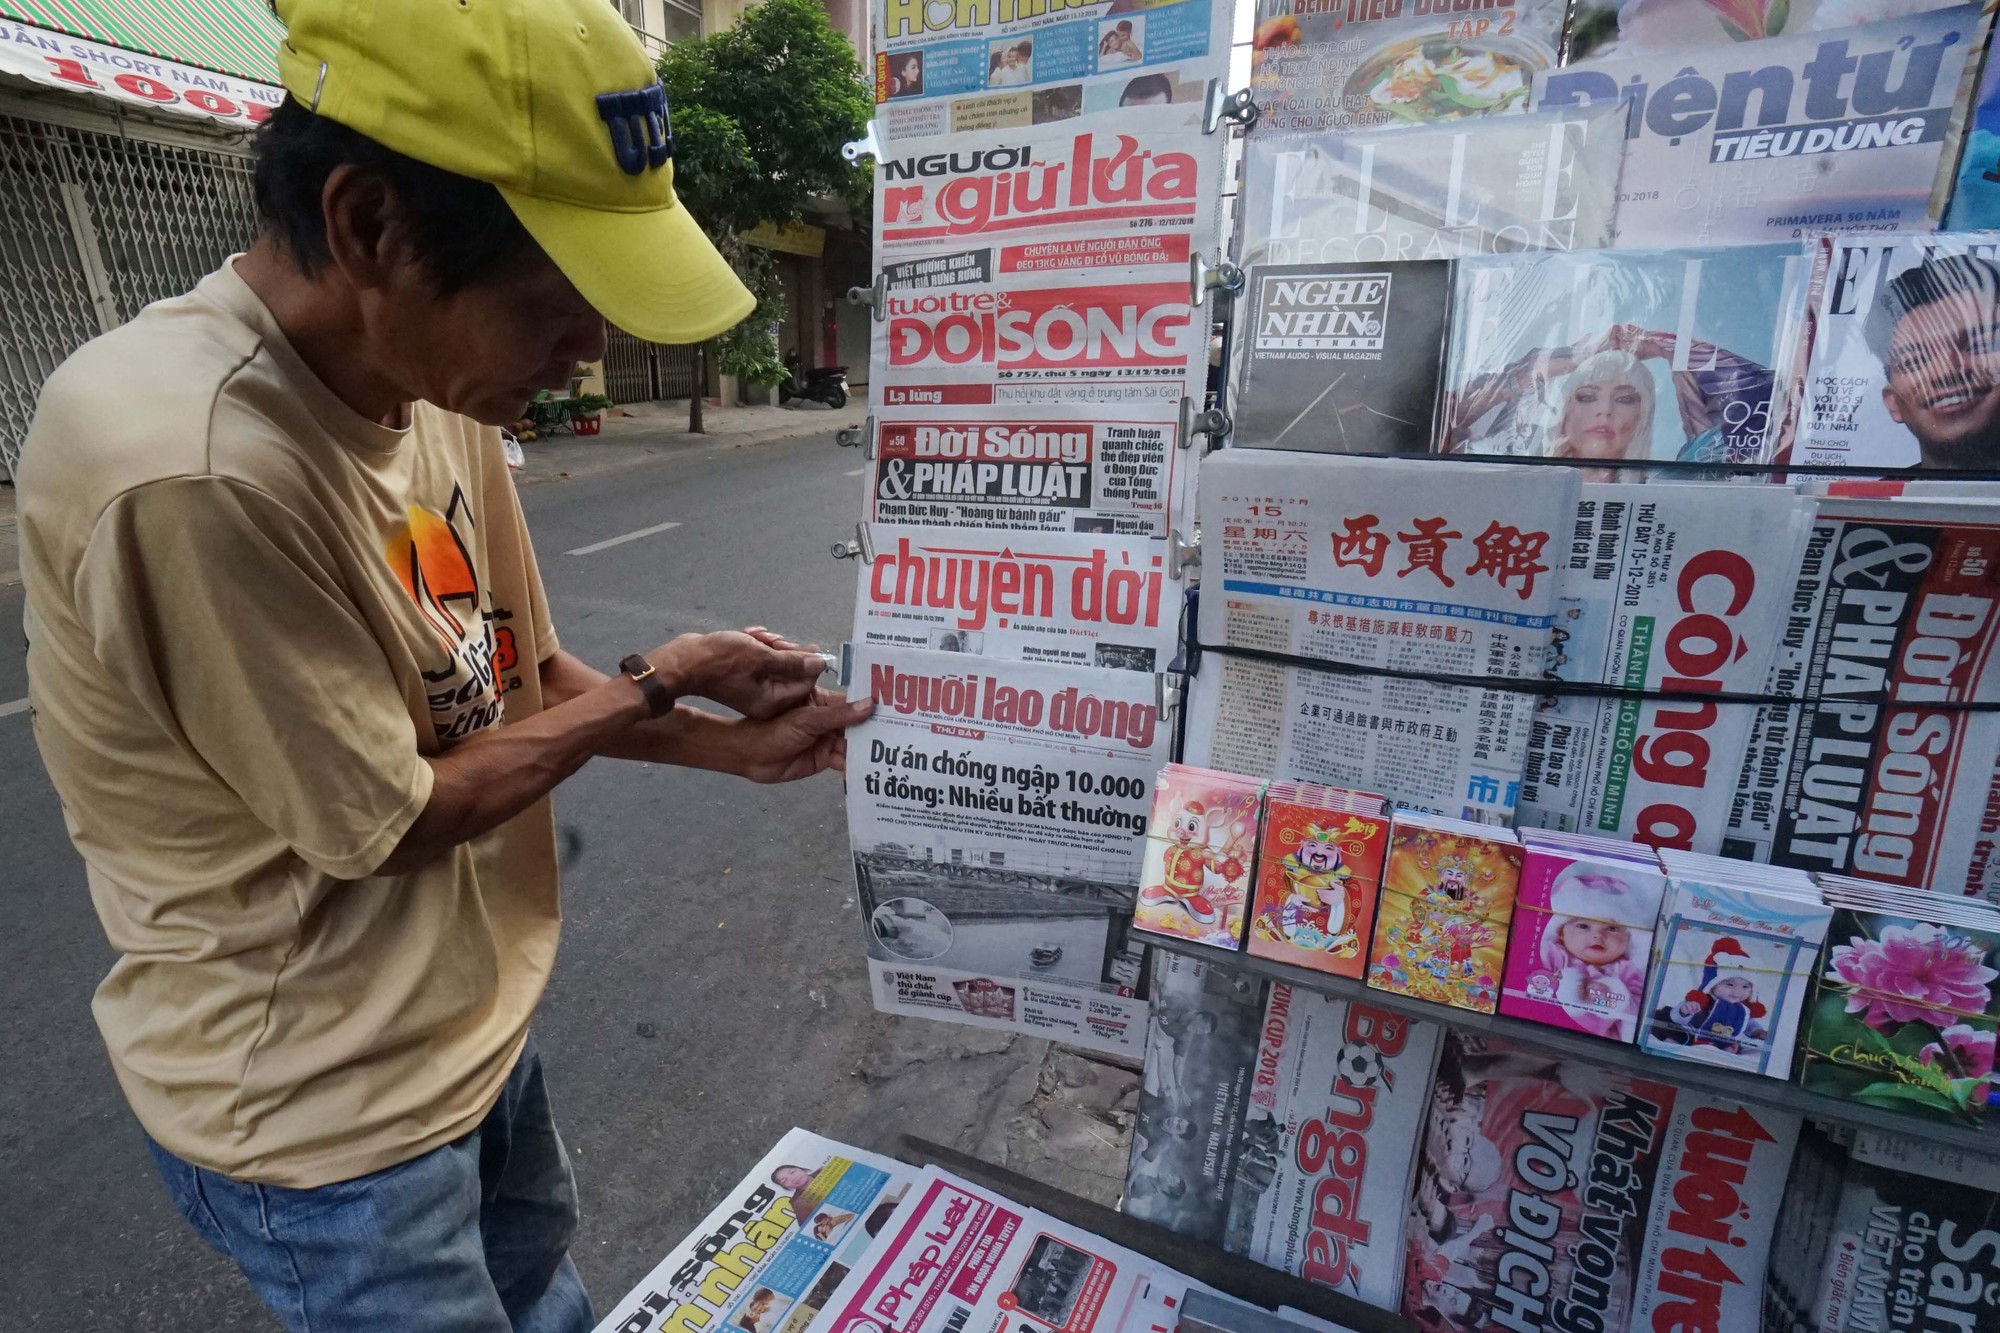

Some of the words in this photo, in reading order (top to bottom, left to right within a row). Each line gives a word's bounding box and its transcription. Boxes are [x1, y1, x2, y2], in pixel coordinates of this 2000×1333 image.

[1447, 14, 1490, 44] TẬP
[1498, 10, 1517, 36] 2
[70, 44, 161, 77] SHORT
[172, 69, 229, 93] NAM
[1290, 114, 1313, 127] CHO
[1713, 129, 1801, 162] TIÊU
[1802, 117, 1925, 155] DÙNG
[885, 145, 1031, 181] NGƯỜI
[935, 160, 1066, 236] giữ
[1633, 190, 1660, 202] 2018
[1139, 218, 1153, 228] 276
[1766, 213, 1843, 227] PRIMAVERA
[1847, 211, 1863, 223] 50
[1865, 207, 1900, 222] NĂM
[1024, 245, 1058, 257] CHUYỆN
[1087, 239, 1116, 252] NGƯỜI
[1117, 238, 1139, 250] ĐÀN
[1140, 237, 1161, 248] ÔNG
[1034, 259, 1056, 268] 13KG
[1056, 255, 1083, 267] VÀNG
[1084, 256, 1094, 266] ĐI
[1124, 251, 1150, 263] BÓNG
[896, 265, 914, 279] VIỆT
[916, 258, 947, 273] HƯƠNG
[931, 270, 956, 285] RƯNG
[958, 266, 982, 281] RƯNG
[1269, 280, 1386, 306] NGHE
[998, 302, 1191, 362] SỐNG
[1261, 305, 1374, 336] NHÌN
[1262, 339, 1376, 347] VIETNAM
[1287, 352, 1310, 360] AUDIO
[1316, 352, 1341, 360] VISUAL
[1343, 352, 1383, 361] MAGAZINE
[1117, 367, 1186, 377] 13/12/2018
[889, 389, 906, 405] Lạ
[998, 388, 1013, 399] Thu
[1030, 387, 1045, 397] khu
[1048, 384, 1061, 397] đất
[1065, 387, 1086, 400] vàng
[1097, 388, 1121, 400] trung
[1124, 387, 1141, 397] tâm
[1144, 386, 1157, 397] Sài
[1160, 386, 1180, 397] Gòn
[1723, 400, 1772, 433] 95
[1814, 404, 1860, 413] MUAY
[914, 426, 980, 457] Đời
[983, 425, 1088, 463] Sống
[1102, 439, 1133, 450] quanh
[1135, 439, 1164, 451] chiếc
[1107, 427, 1136, 438] Tranh
[1138, 428, 1160, 440] luận
[1101, 451, 1116, 462] thẻ
[1118, 450, 1140, 464] điệp
[1142, 451, 1164, 463] viên
[1112, 463, 1137, 475] Đông
[1139, 464, 1158, 475] Đức
[913, 460, 999, 495] PHÁP
[1002, 461, 1088, 502] LUẬT
[1103, 487, 1130, 500] thống
[1132, 488, 1157, 500] Putin
[1109, 475, 1126, 486] của
[1128, 475, 1152, 488] Tổng
[879, 502, 906, 517] Phạm
[908, 503, 927, 516] Đức
[929, 505, 949, 519] Huy
[956, 506, 994, 521] "Hoàng
[1009, 508, 1036, 521] bánh
[1131, 502, 1152, 510] Trang
[1247, 505, 1282, 516] 15
[1223, 525, 1308, 542] 星期六
[1802, 526, 1835, 576] Phạm
[1624, 548, 1647, 607] 15-12-2018
[1959, 557, 1988, 577] 50
[870, 538, 1053, 630] chuyện
[1071, 549, 1163, 628] đời
[1792, 578, 1818, 613] Đức
[1782, 616, 1812, 649] Huy
[1895, 593, 1994, 702] Đời
[1628, 623, 1650, 685] THÀNH
[1818, 588, 1908, 734] PHÁP
[871, 663, 978, 720] Người
[982, 676, 1044, 727] lao
[1050, 686, 1157, 749] động
[936, 725, 955, 734] THỨ
[957, 727, 980, 738] BẢY
[871, 739, 900, 772] Dự
[902, 743, 928, 771] án
[932, 749, 997, 787] chống
[1002, 758, 1060, 794] ngập
[1065, 770, 1145, 799] 10.000
[1611, 753, 1626, 782] CHÍ
[865, 769, 880, 796] tỉ
[884, 775, 945, 809] đồng:
[949, 785, 1014, 815] Nhiều
[1018, 794, 1056, 821] bất
[1061, 801, 1147, 836] thường
[1602, 784, 1620, 825] MINH
[1789, 737, 1872, 870] LUẬT
[1853, 712, 1951, 878] Sống
[896, 971, 914, 982] Việt
[915, 973, 936, 983] Nam
[1122, 987, 1130, 997] 4
[911, 989, 936, 1000] giành
[937, 992, 952, 1002] cúp
[1264, 1020, 1286, 1048] CUP
[1258, 1049, 1280, 1087] 2018
[1211, 1105, 1224, 1127] NAM
[1202, 1131, 1221, 1177] MALAYSIA
[1583, 1088, 1660, 1218] Khát
[1667, 1105, 1778, 1247] tuổi
[699, 1195, 798, 1308] nhân
[1903, 1211, 1938, 1263] cho
[874, 1245, 942, 1322] Pháp
[925, 1196, 973, 1246] luật
[1551, 1213, 1624, 1333] vọng
[1848, 1265, 1892, 1333] NAM
[1886, 1267, 1926, 1326] trận
